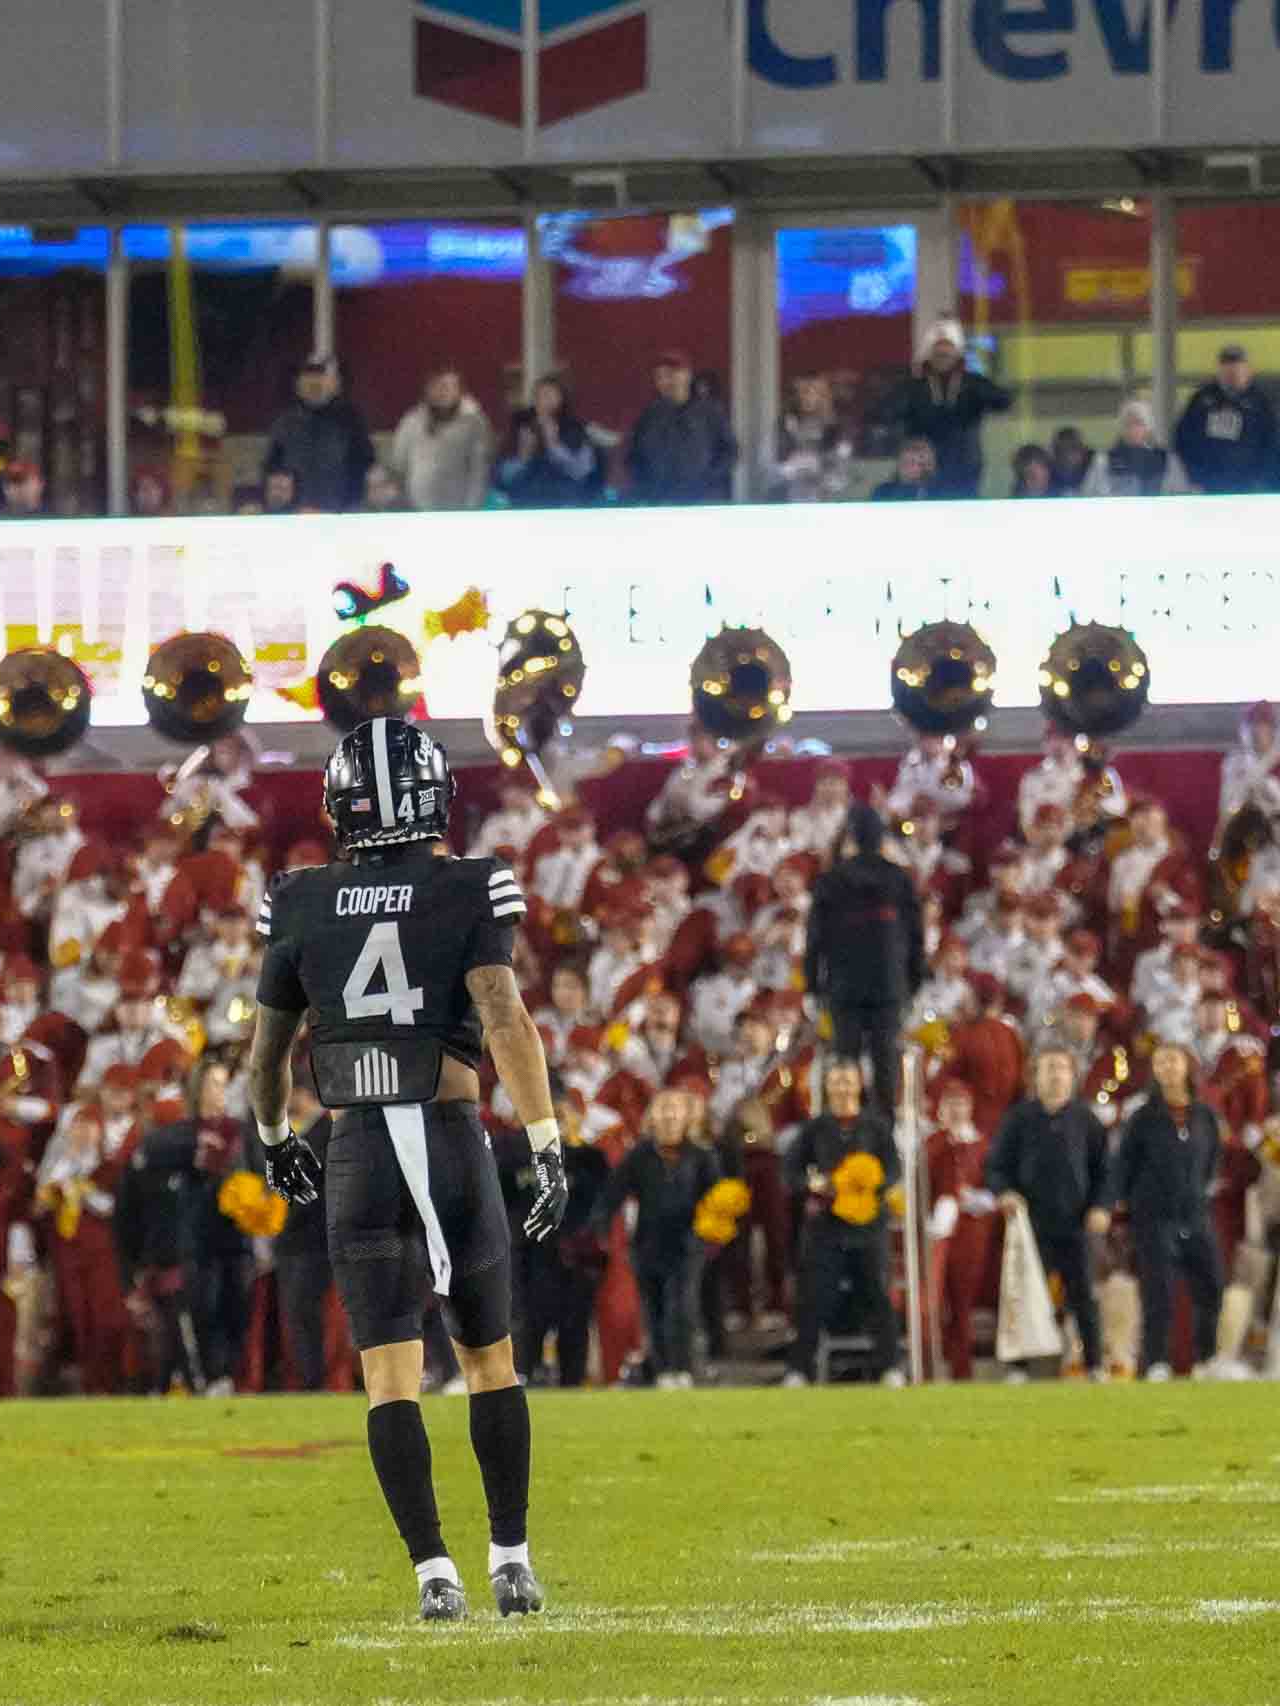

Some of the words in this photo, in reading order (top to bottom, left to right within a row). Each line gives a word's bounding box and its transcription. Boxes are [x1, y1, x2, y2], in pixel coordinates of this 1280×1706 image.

[746, 0, 1280, 89] Chevr
[398, 792, 415, 823] 4
[335, 885, 413, 916] COOPER
[342, 921, 424, 1025] 4
